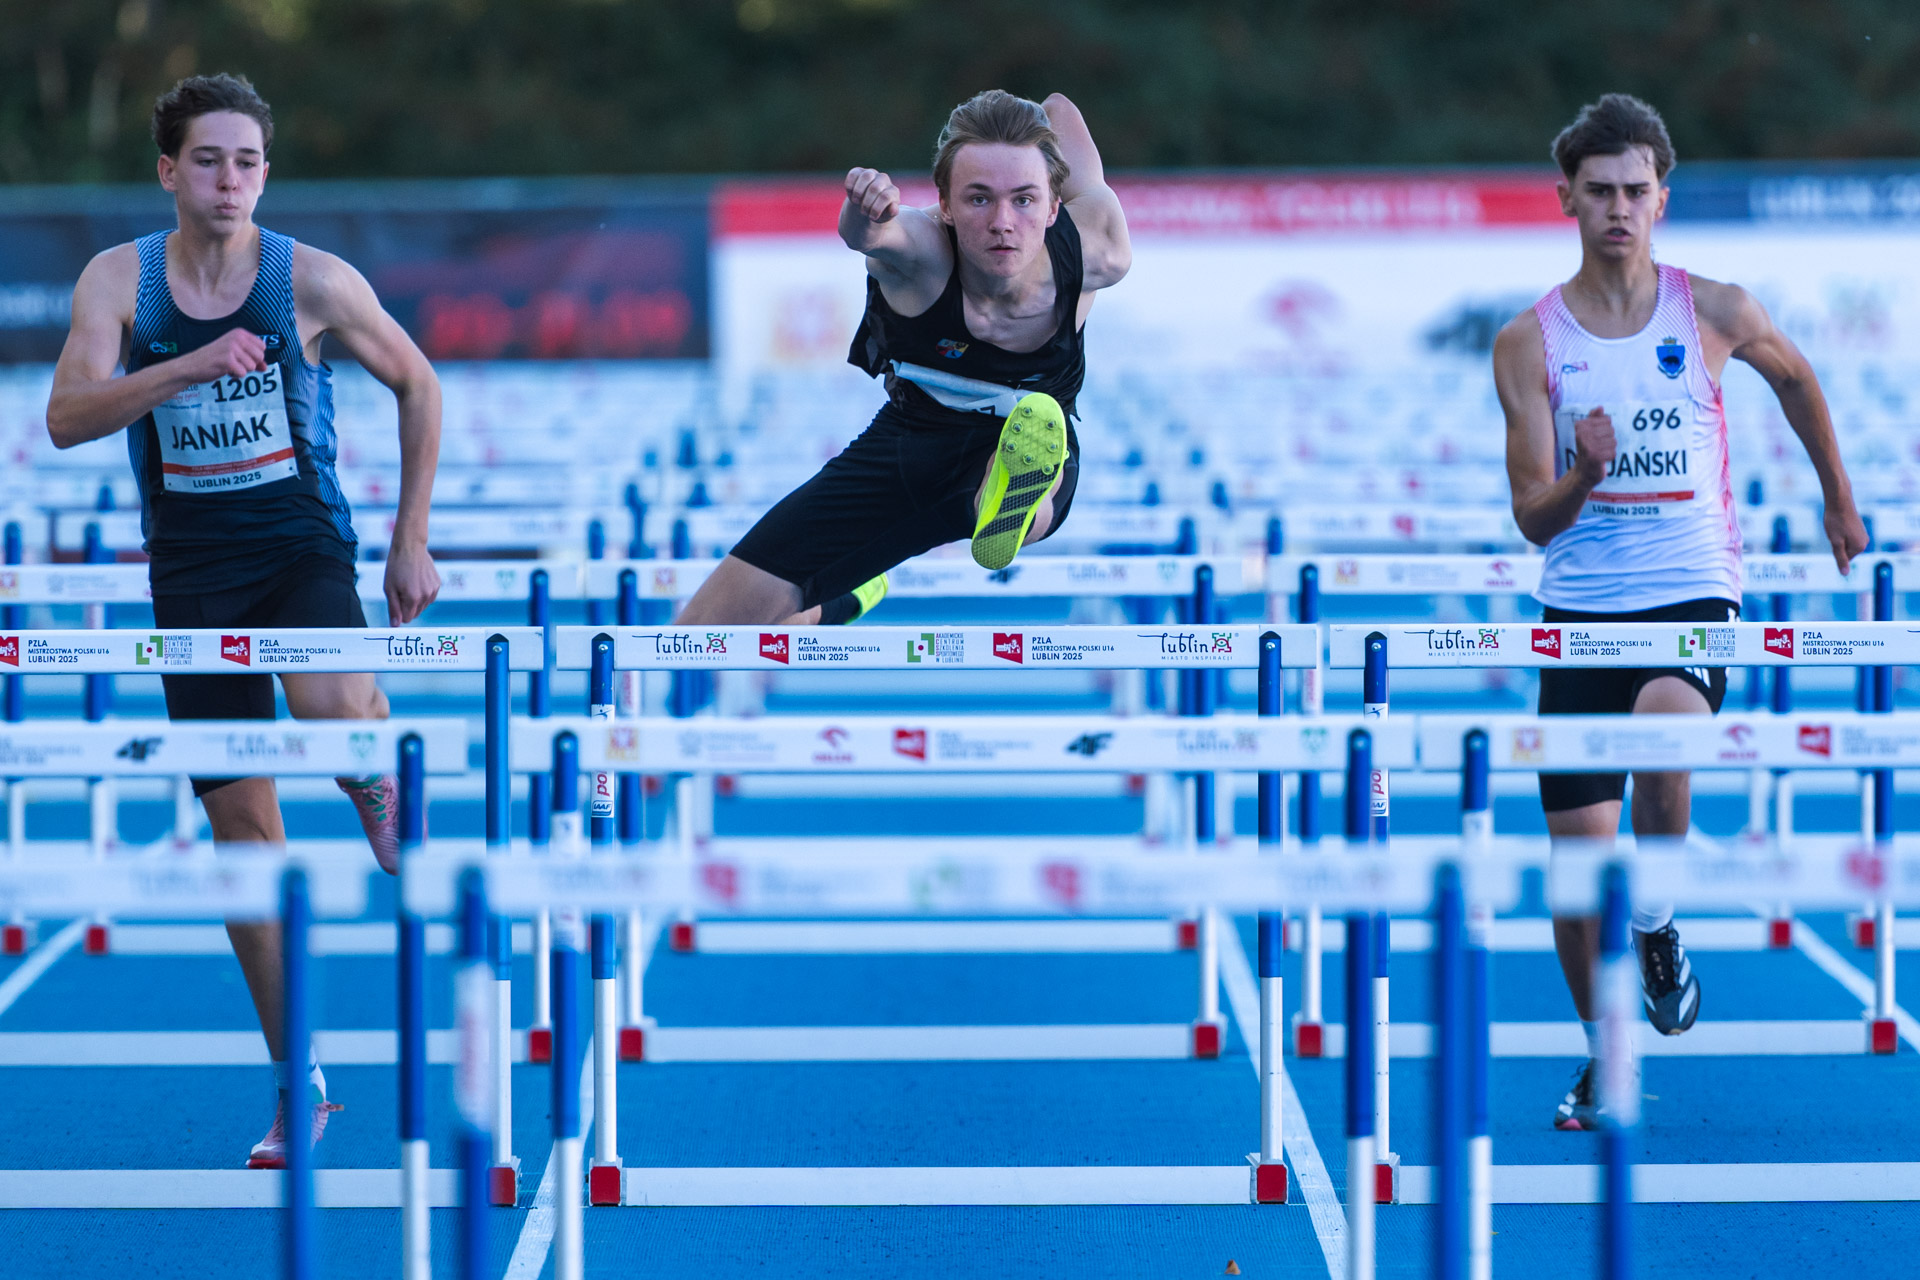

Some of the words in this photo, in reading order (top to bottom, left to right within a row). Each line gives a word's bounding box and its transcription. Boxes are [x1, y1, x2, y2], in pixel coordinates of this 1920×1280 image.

[211, 369, 277, 403] 1205
[1631, 408, 1681, 431] 696
[172, 413, 273, 451] JANIAK
[193, 476, 231, 489] LUBLIN
[233, 471, 262, 486] 2025
[1592, 503, 1629, 516] LUBLIN
[1631, 505, 1660, 516] 2025
[28, 639, 48, 647] PZLA
[259, 639, 280, 647] PZLA
[364, 635, 435, 656] lublin
[632, 633, 703, 654] lublin
[798, 637, 818, 645] PZLA
[1137, 632, 1208, 653] lublin
[1403, 629, 1475, 650] lublin
[798, 653, 826, 661] LUBLIN
[828, 653, 849, 661] 2025
[1032, 652, 1060, 660] LUBLIN
[1062, 652, 1083, 660] 2025
[1802, 647, 1830, 655] LUBLIN
[1832, 647, 1853, 655] 2025
[28, 655, 56, 663] LUBLIN
[58, 655, 78, 663] 2025
[259, 655, 287, 663] LUBLIN
[289, 655, 310, 663] 2025
